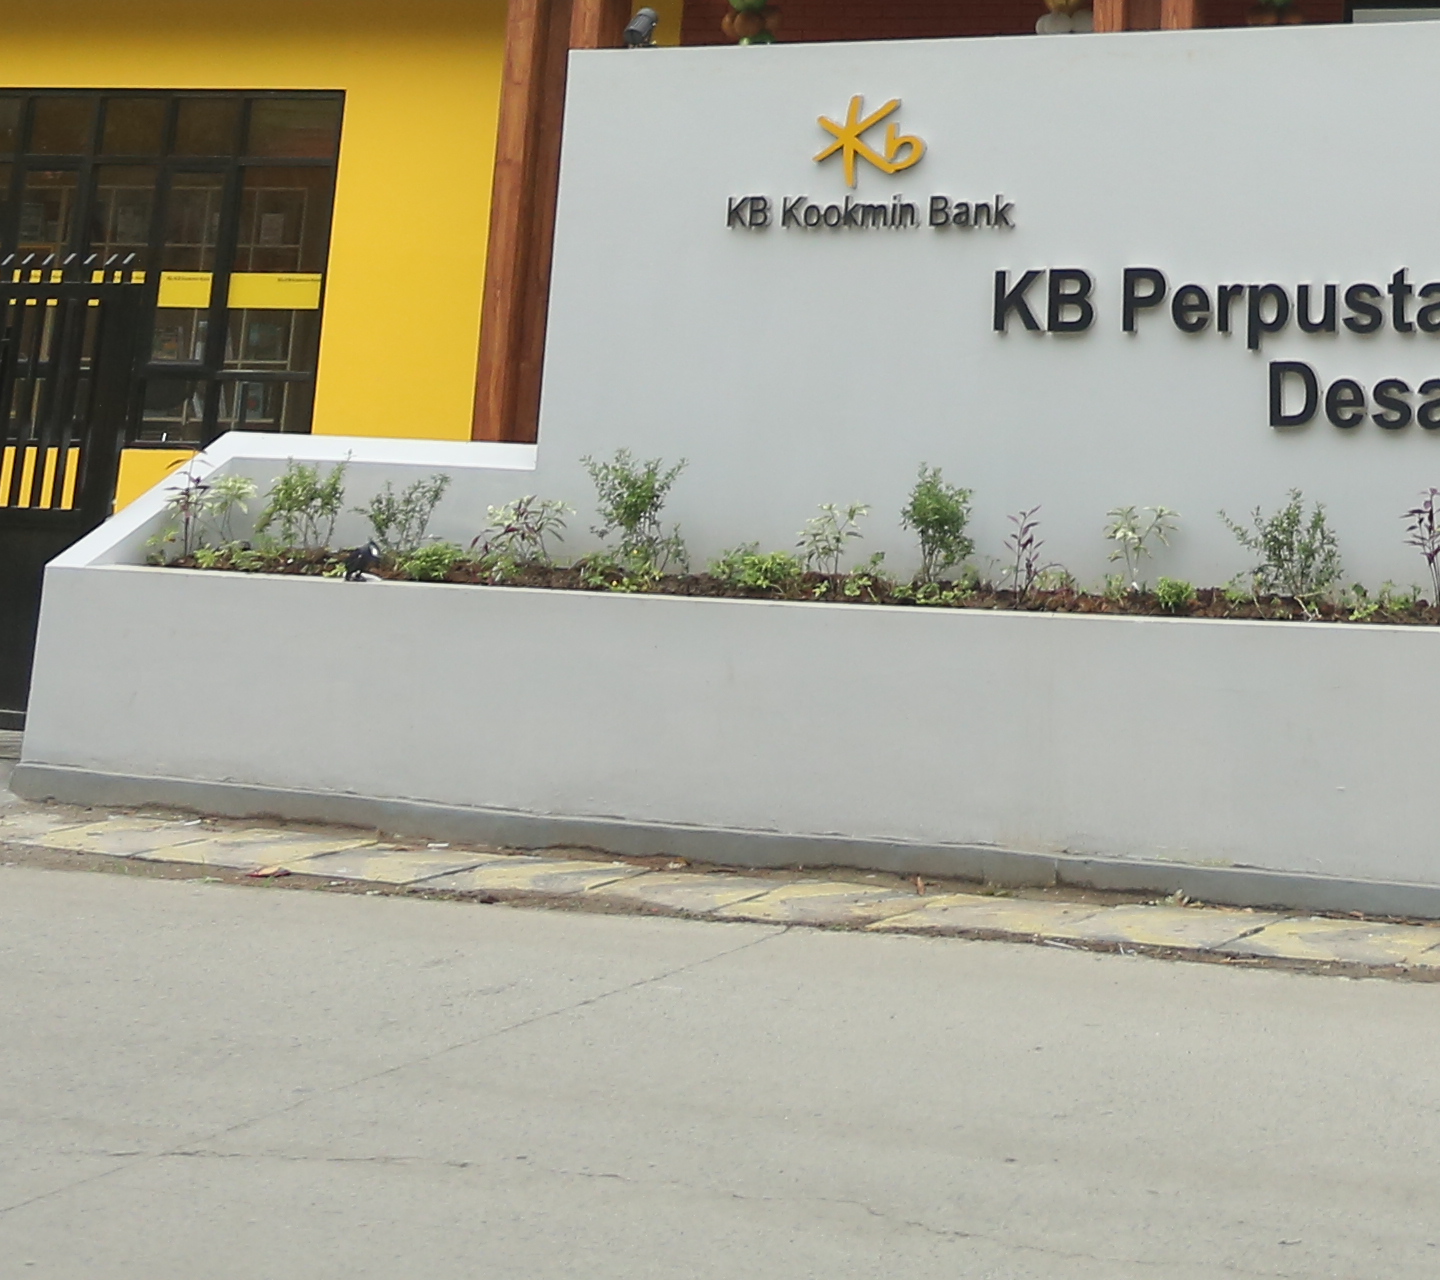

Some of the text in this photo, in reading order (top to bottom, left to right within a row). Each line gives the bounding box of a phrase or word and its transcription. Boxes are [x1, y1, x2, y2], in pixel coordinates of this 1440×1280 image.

[725, 193, 1016, 229] KB Kookmin Bank
[993, 268, 1096, 334] KB
